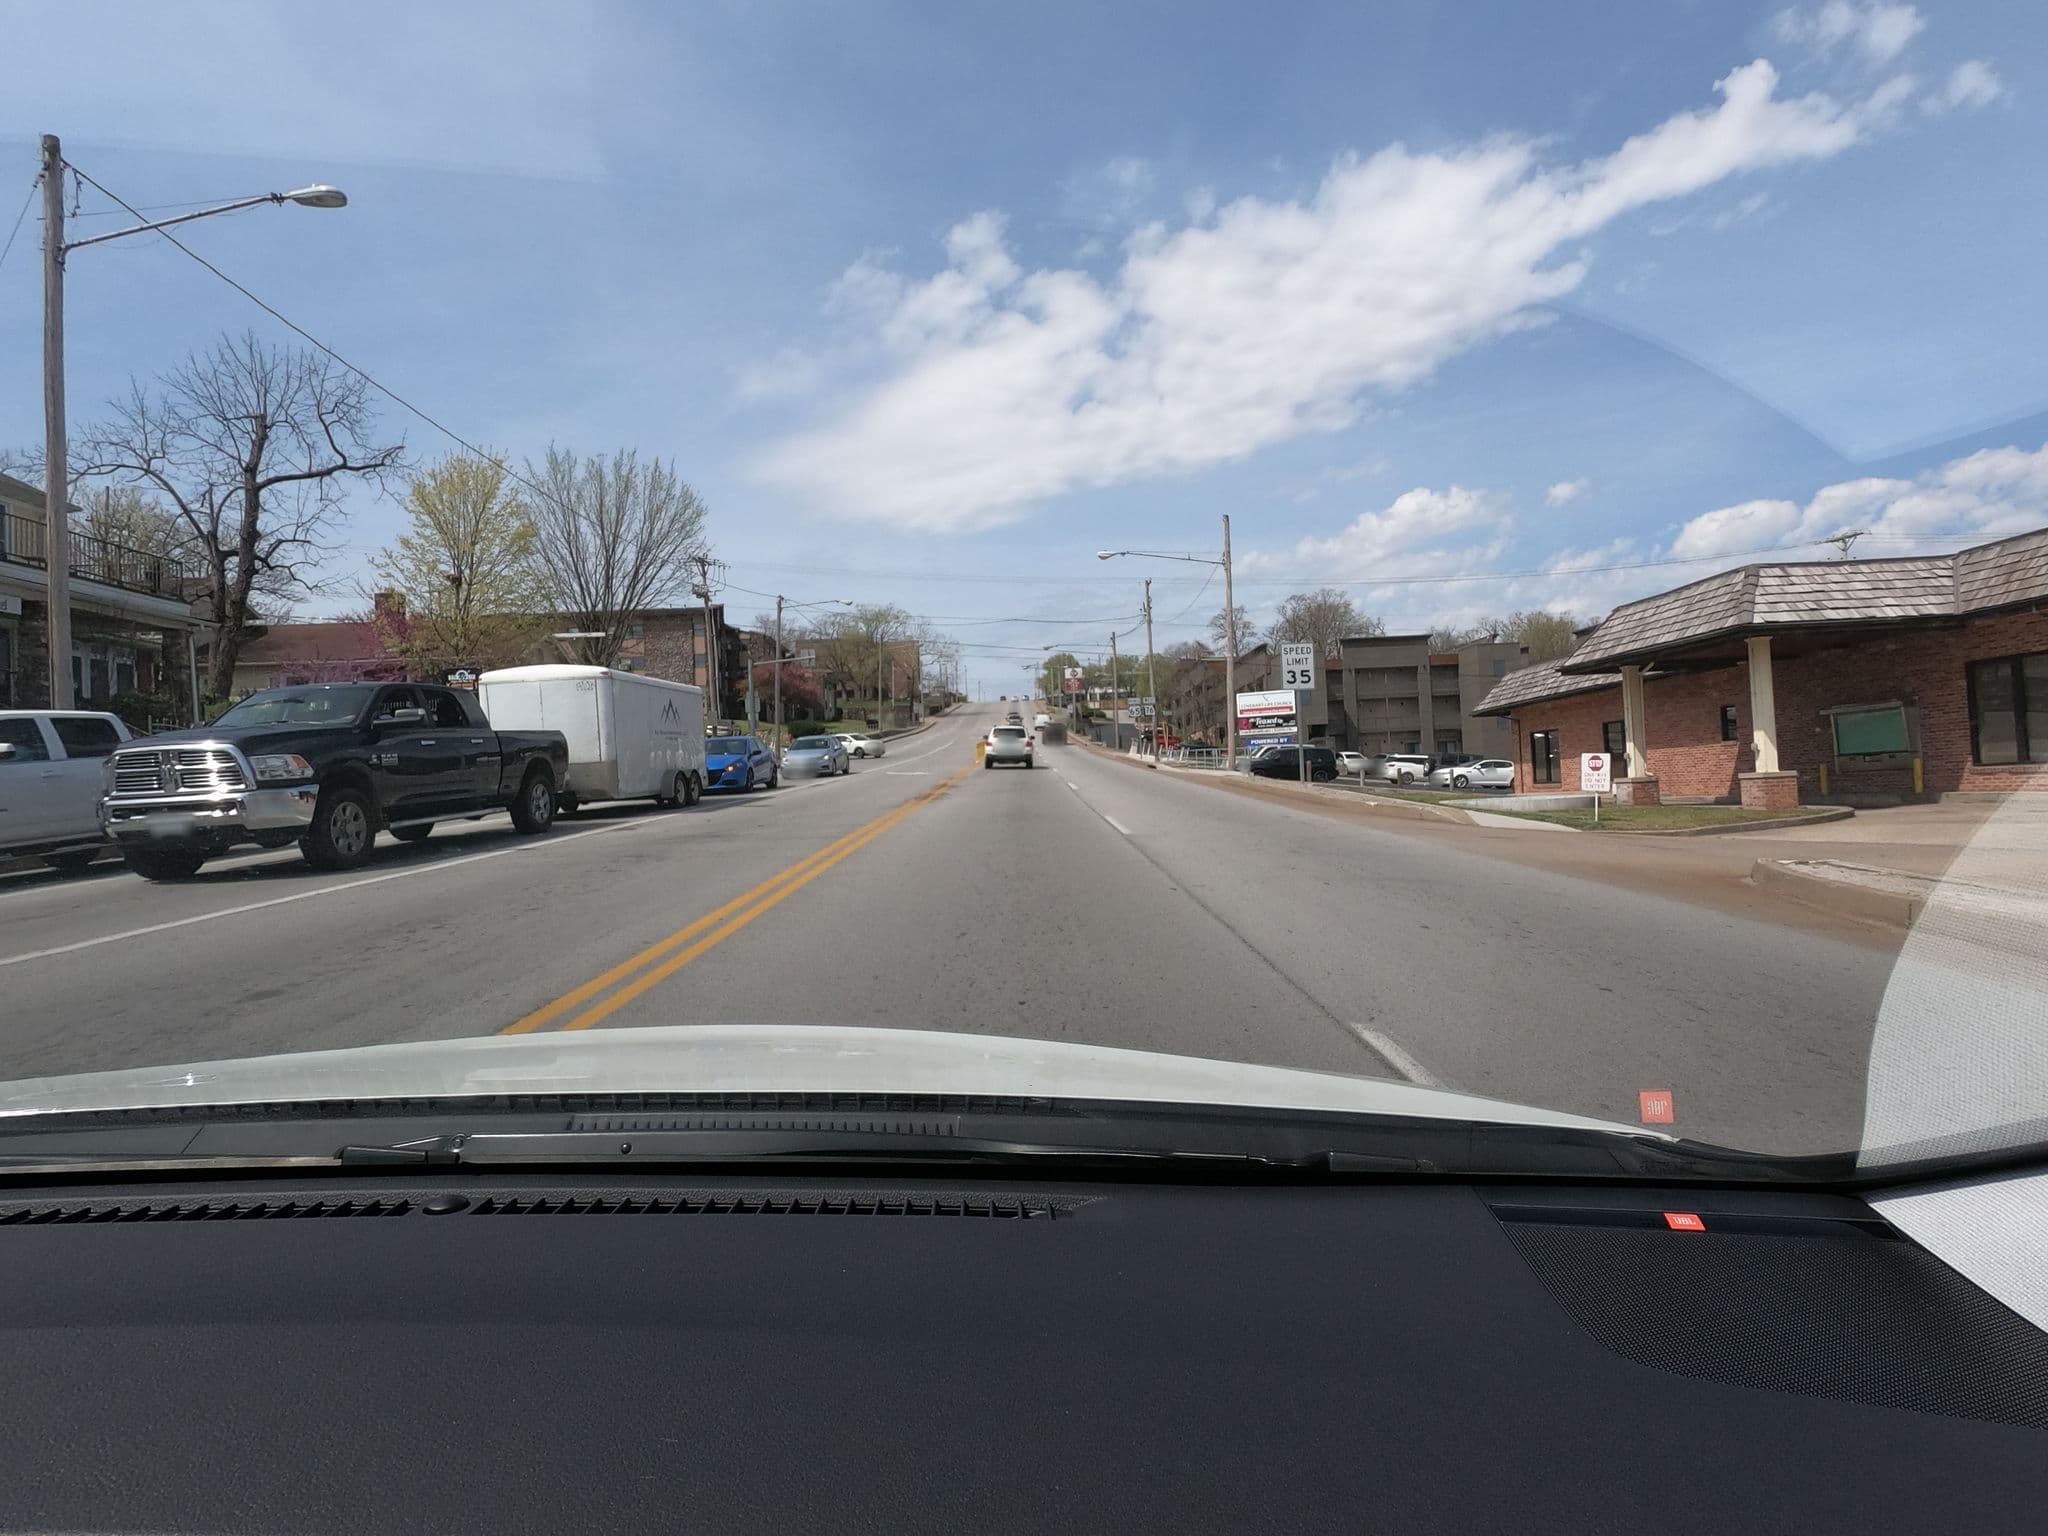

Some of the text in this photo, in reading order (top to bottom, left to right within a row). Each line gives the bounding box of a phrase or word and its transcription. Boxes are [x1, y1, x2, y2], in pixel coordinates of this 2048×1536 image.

[1283, 647, 1311, 655] SPEED
[1286, 657, 1309, 666] LIMIT
[1286, 669, 1311, 684] 35
[1129, 707, 1140, 716] 65
[1145, 706, 1154, 714] 76
[1588, 759, 1603, 768] STOP
[1673, 1216, 1696, 1225] JBL
